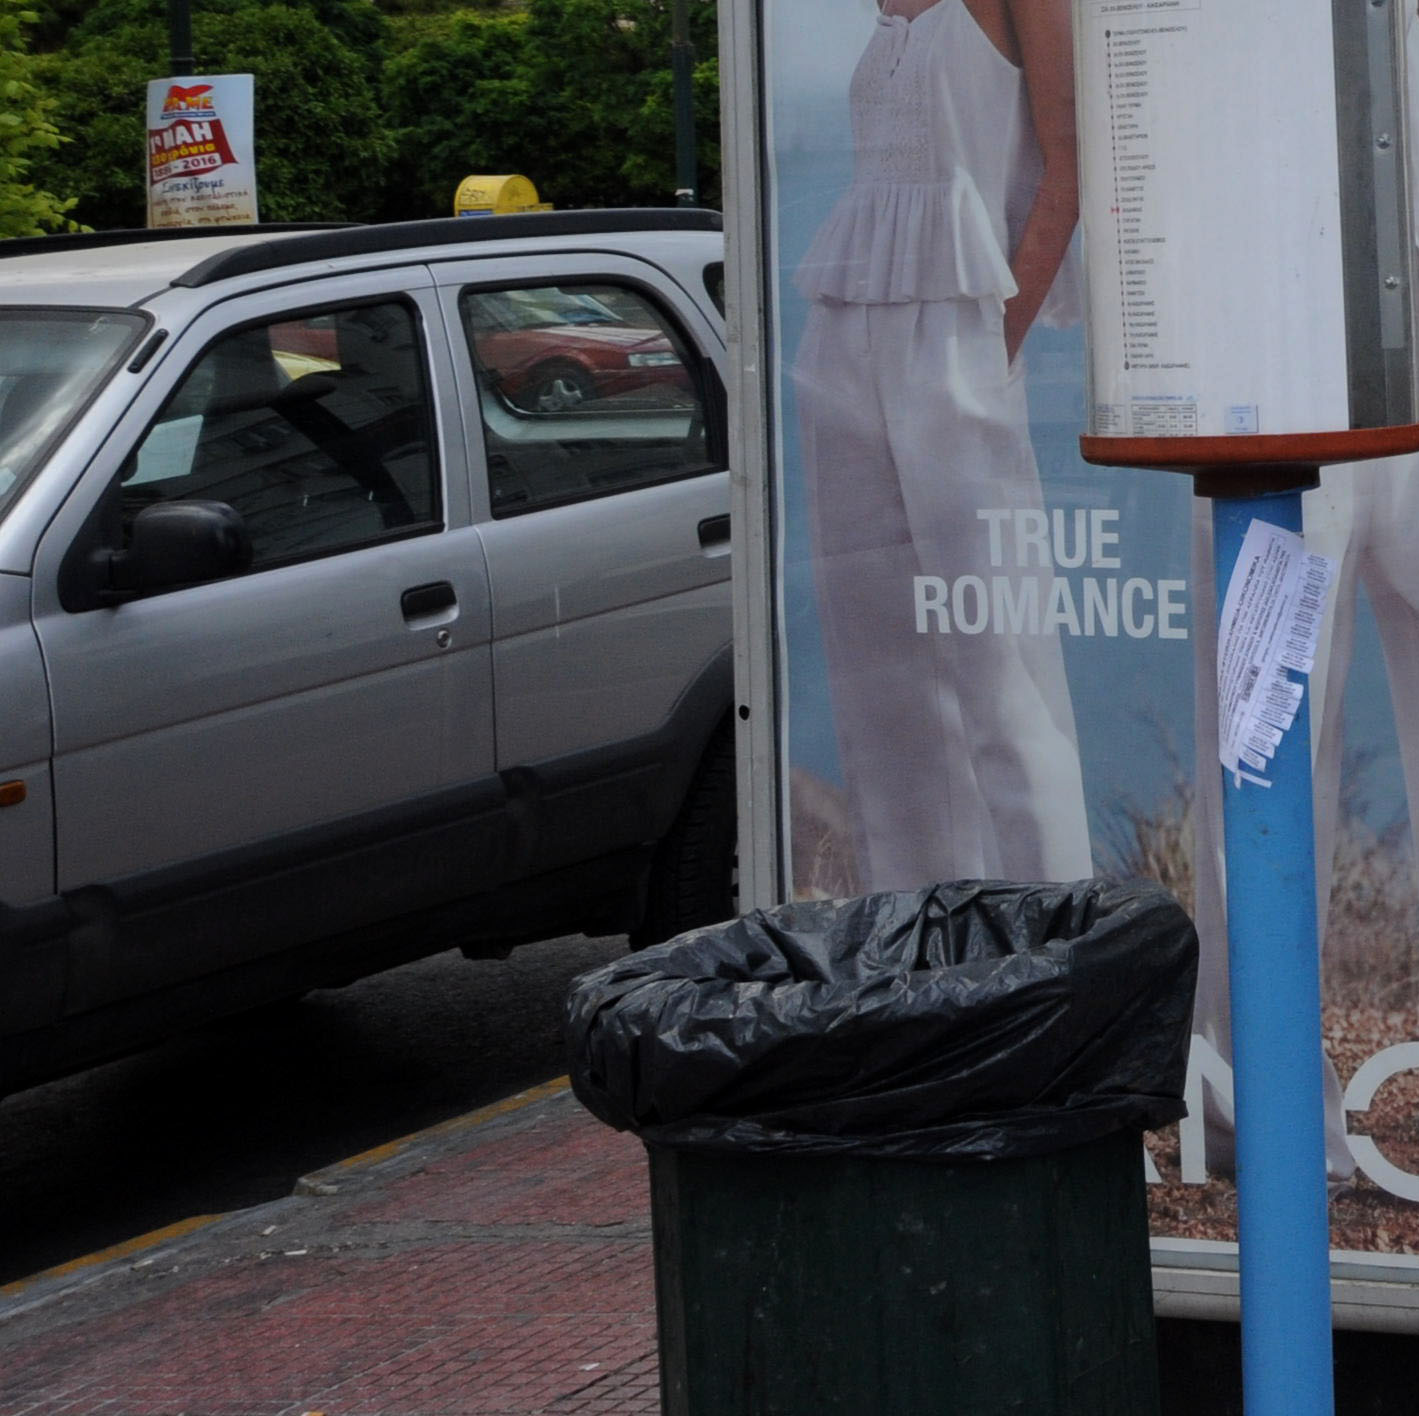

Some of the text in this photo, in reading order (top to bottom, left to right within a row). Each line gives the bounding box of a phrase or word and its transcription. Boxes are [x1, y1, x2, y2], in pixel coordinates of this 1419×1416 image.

[182, 156, 217, 170] 2016
[976, 509, 1121, 568] TRUE
[913, 575, 1189, 639] ROMANCE
